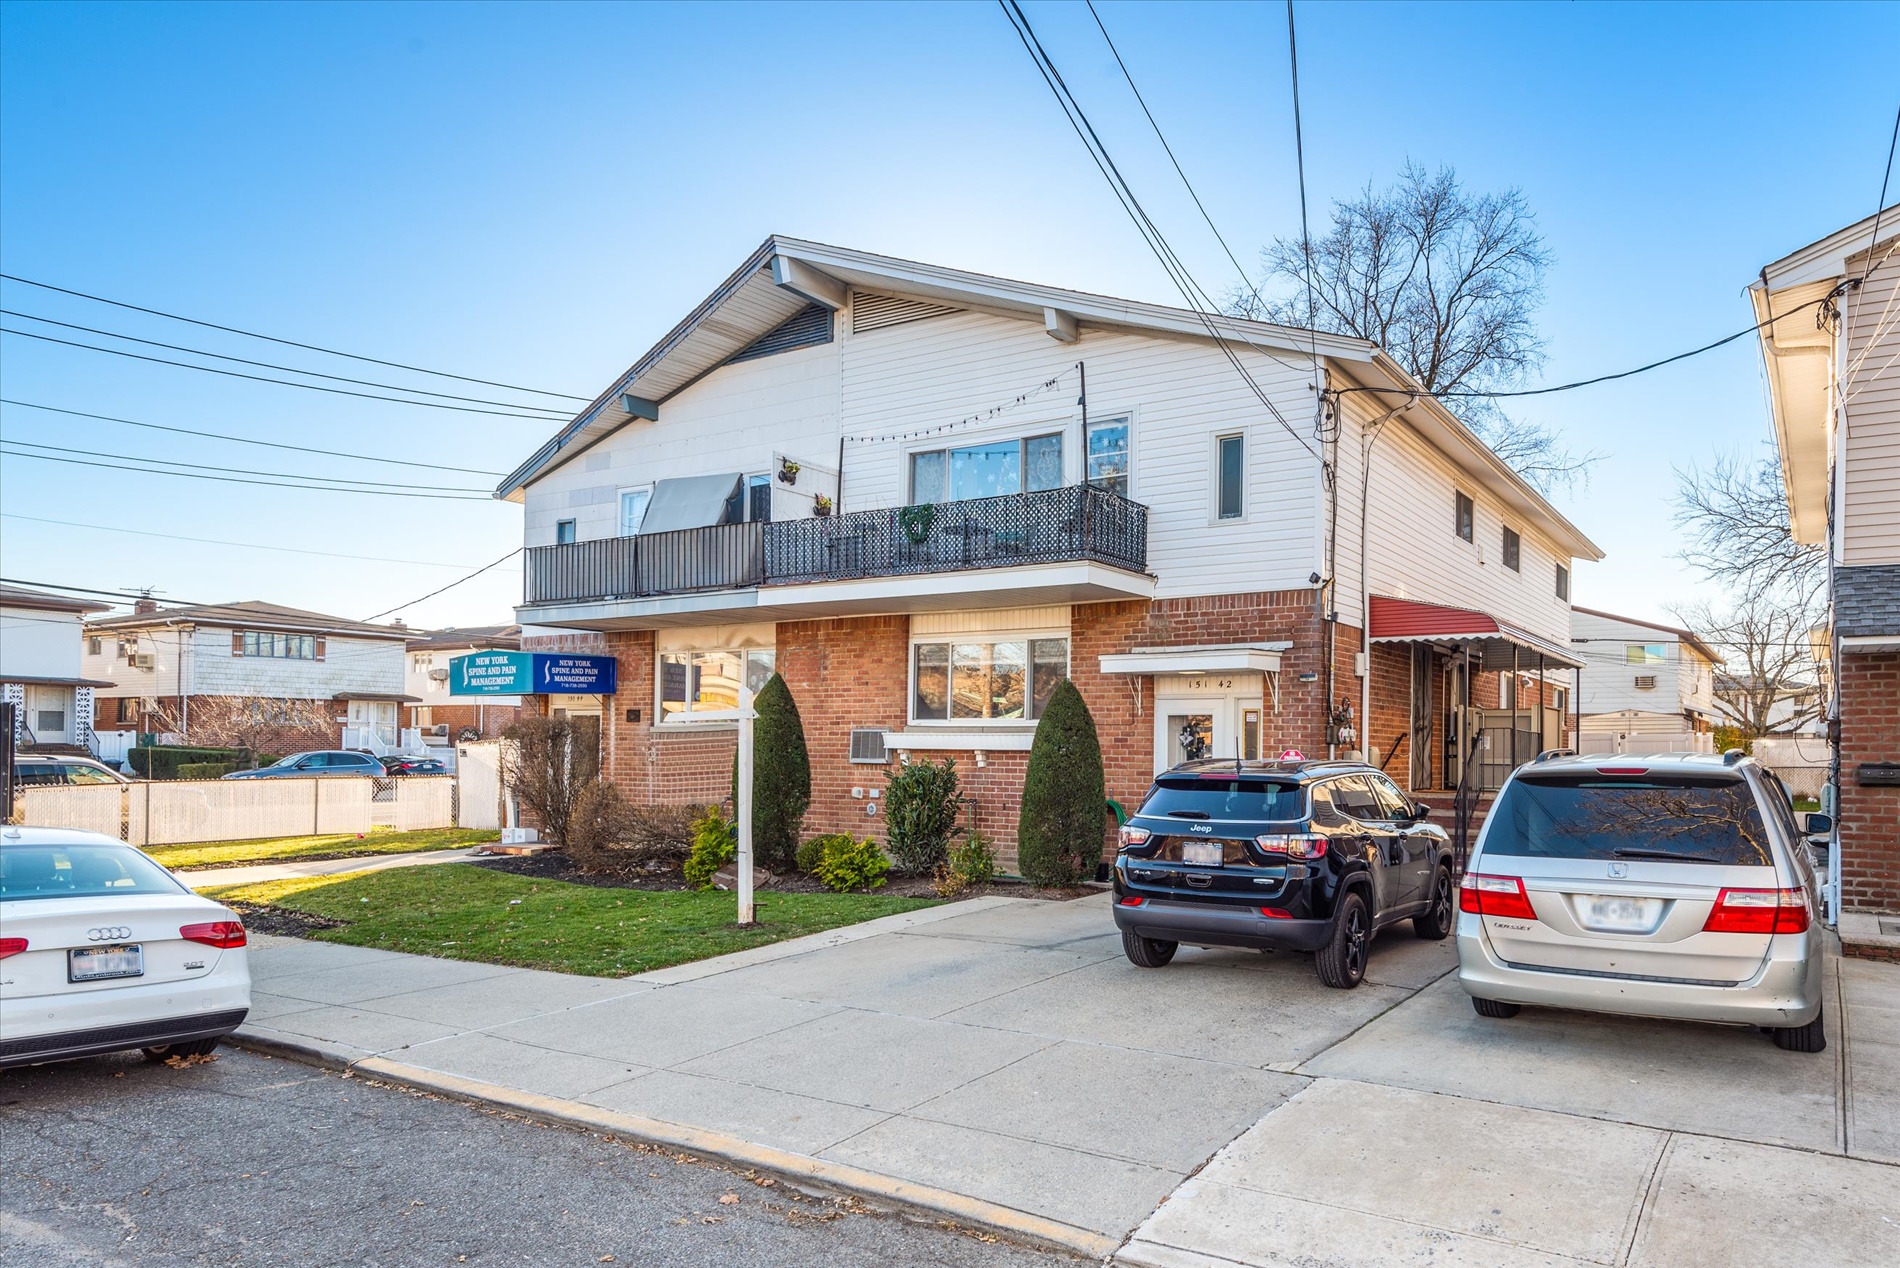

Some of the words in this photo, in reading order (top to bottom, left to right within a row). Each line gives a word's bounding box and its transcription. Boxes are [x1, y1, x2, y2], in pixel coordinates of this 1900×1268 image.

[475, 657, 490, 666] NEW
[491, 656, 509, 665] YORK
[559, 659, 574, 667] NEW
[468, 667, 487, 676] SPINE
[487, 666, 501, 675] AND
[501, 665, 517, 674] PAIN
[471, 676, 514, 686] MANAGEMENT
[554, 675, 597, 683] MANAGEMENT
[1189, 680, 1207, 689] 151
[1218, 680, 1232, 689] 42
[1190, 823, 1212, 834] Jeep
